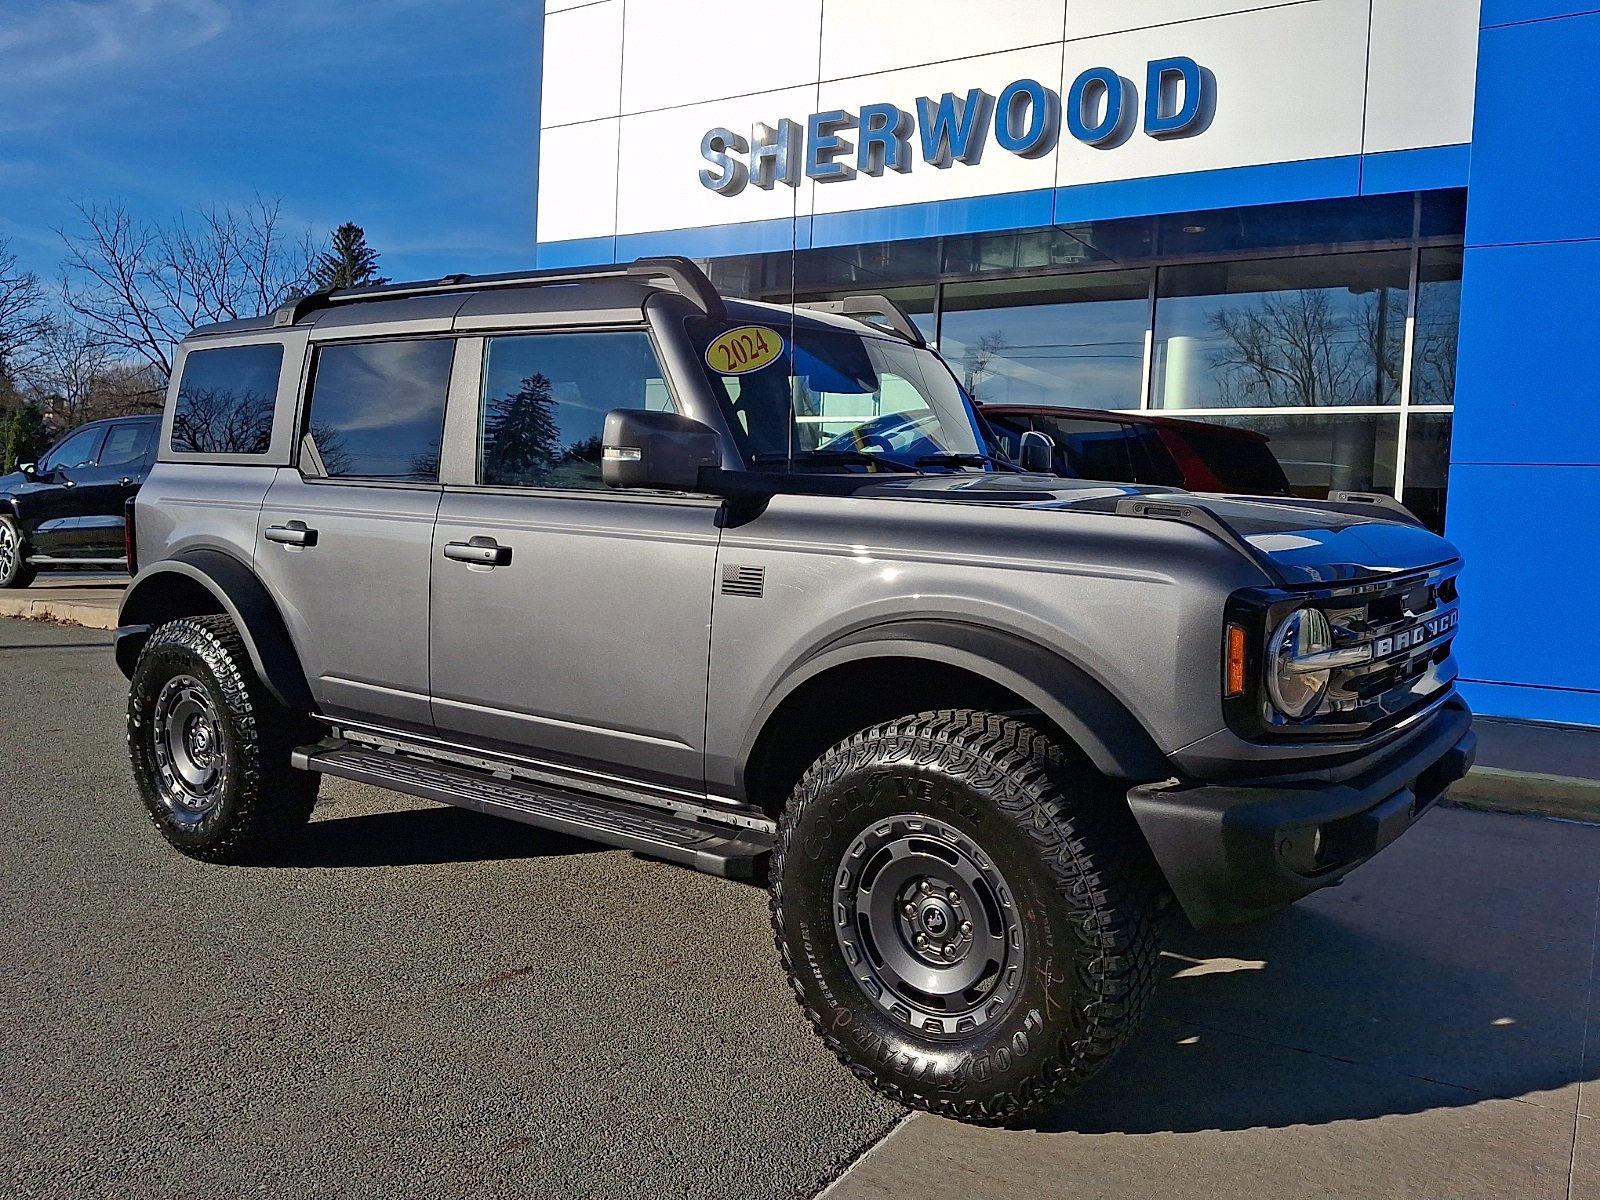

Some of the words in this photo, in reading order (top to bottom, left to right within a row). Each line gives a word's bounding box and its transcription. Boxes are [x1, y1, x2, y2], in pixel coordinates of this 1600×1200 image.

[699, 56, 1217, 197] SHERWOOD
[718, 329, 769, 370] 2024
[1376, 610, 1459, 657] BRONCO
